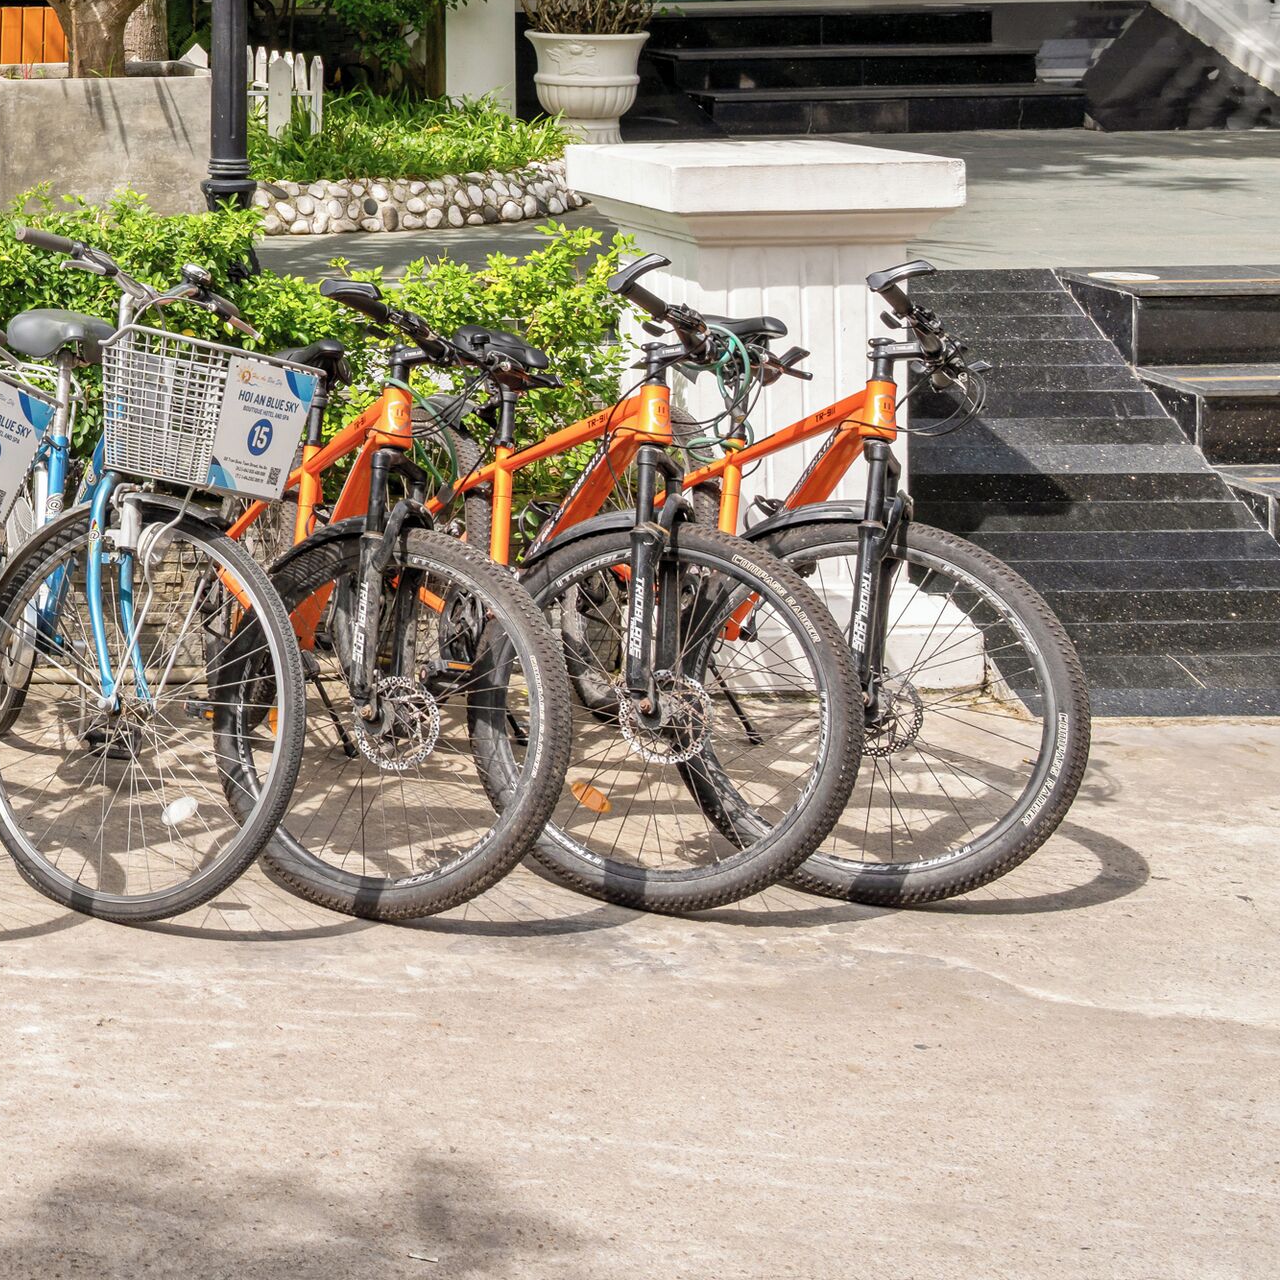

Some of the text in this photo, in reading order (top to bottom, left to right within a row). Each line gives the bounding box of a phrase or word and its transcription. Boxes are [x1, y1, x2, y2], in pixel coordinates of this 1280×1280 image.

[238, 389, 299, 414] HOI AN BLUE SKY
[242, 404, 262, 414] BOUTIQUE
[262, 409, 274, 417] HOTEL
[3, 432, 13, 440] AND
[12, 436, 20, 444] SPA
[14, 423, 31, 438] SKY
[251, 425, 270, 449] 15
